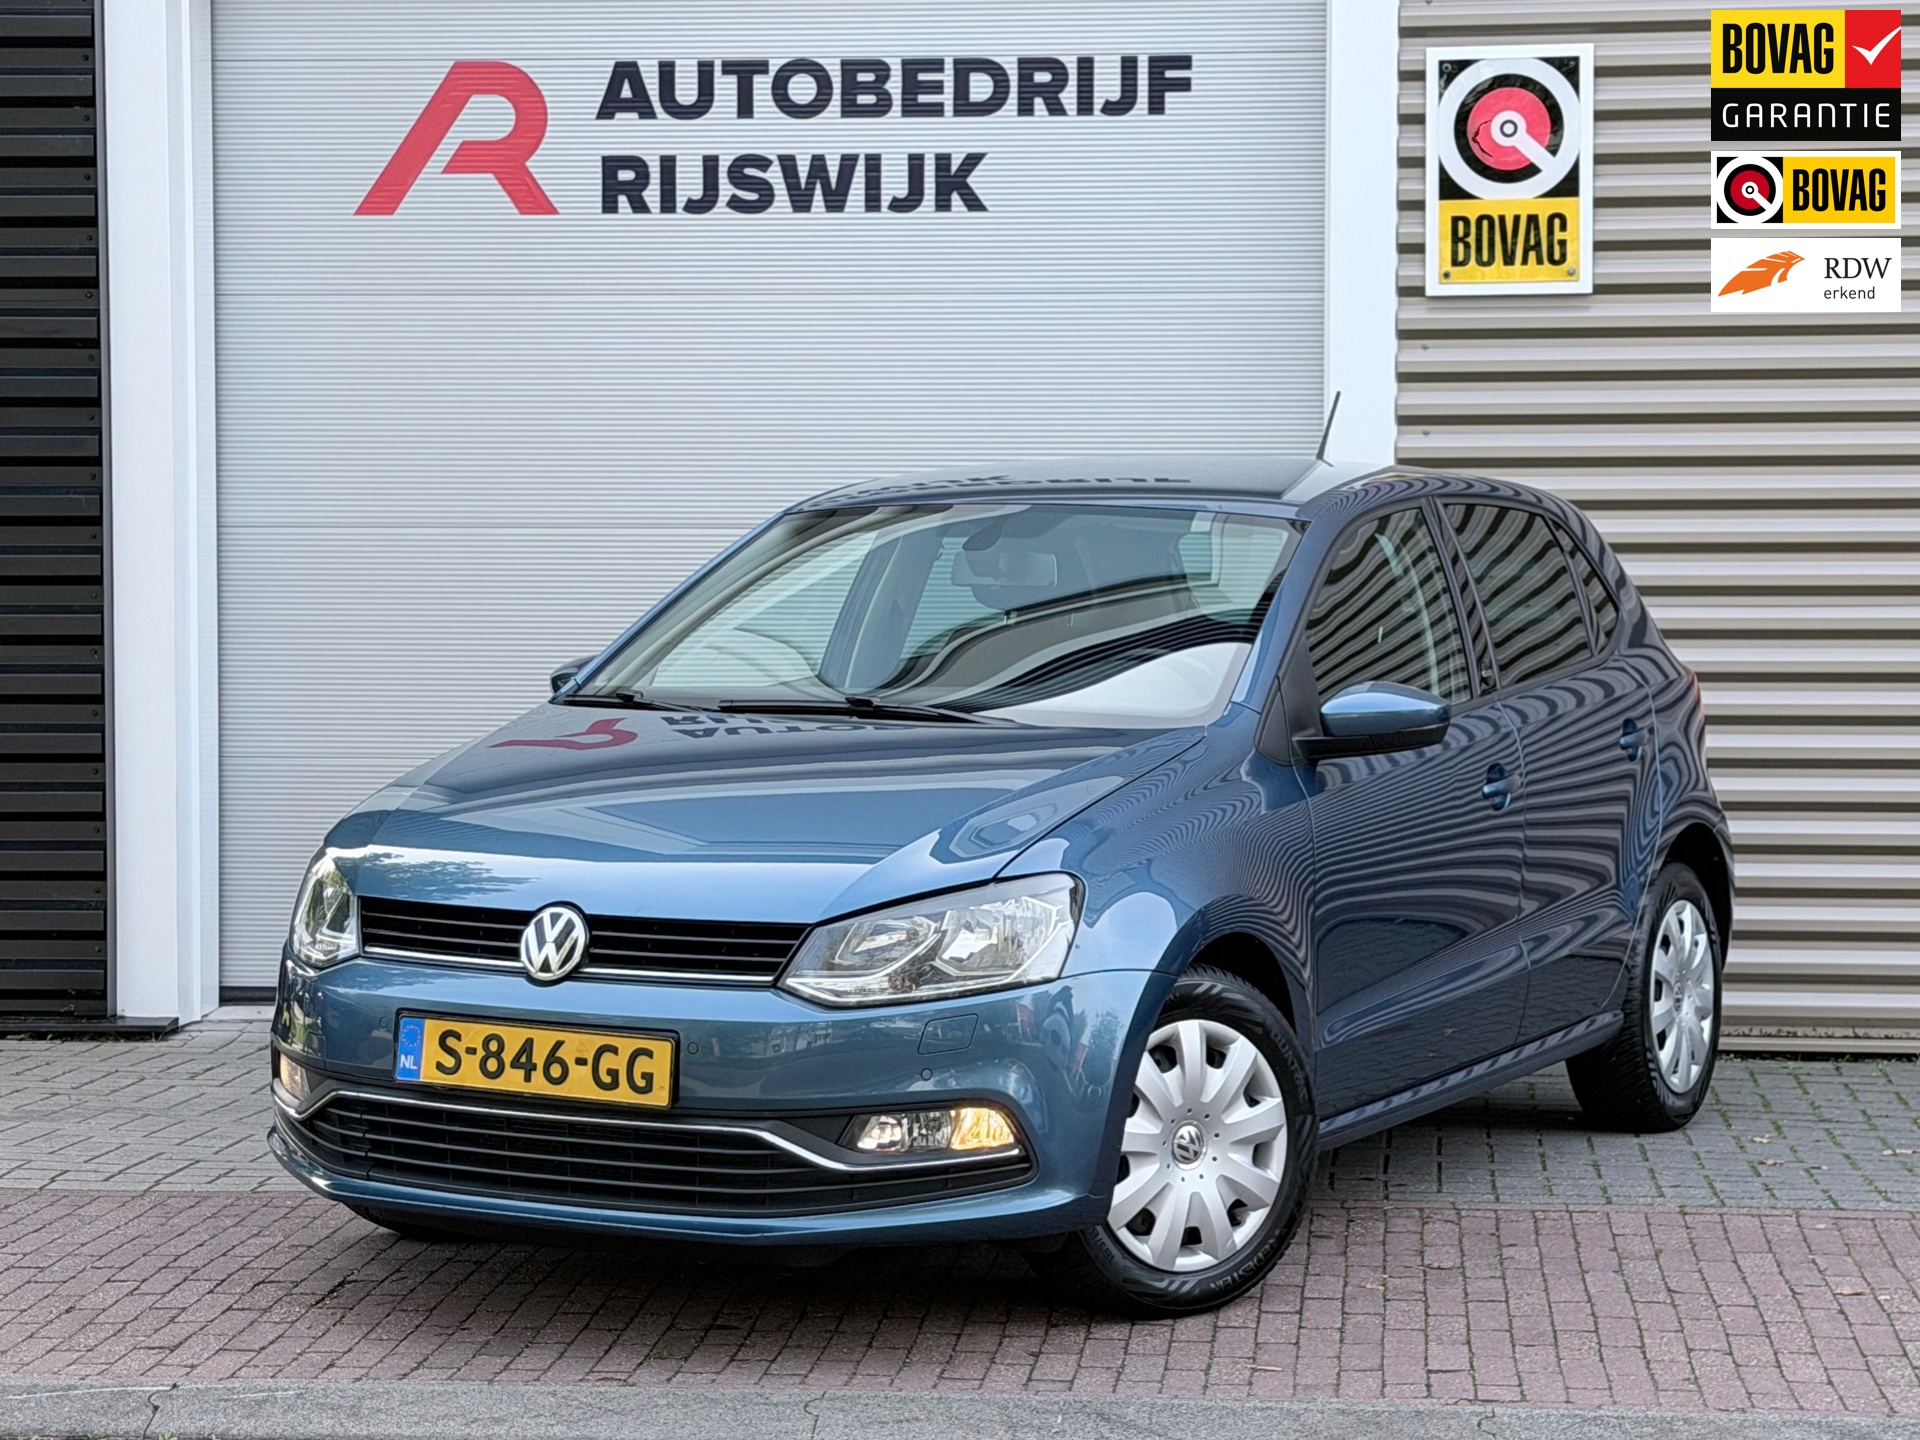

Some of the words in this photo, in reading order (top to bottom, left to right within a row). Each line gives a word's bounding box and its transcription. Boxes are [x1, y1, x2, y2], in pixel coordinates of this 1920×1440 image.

[595, 54, 1193, 121] AUTOBEDRIJF
[601, 151, 989, 215] RIJSWIJK
[1450, 211, 1568, 268] BOVAG
[400, 1054, 418, 1070] NL
[434, 1028, 655, 1095] S-846-GG
